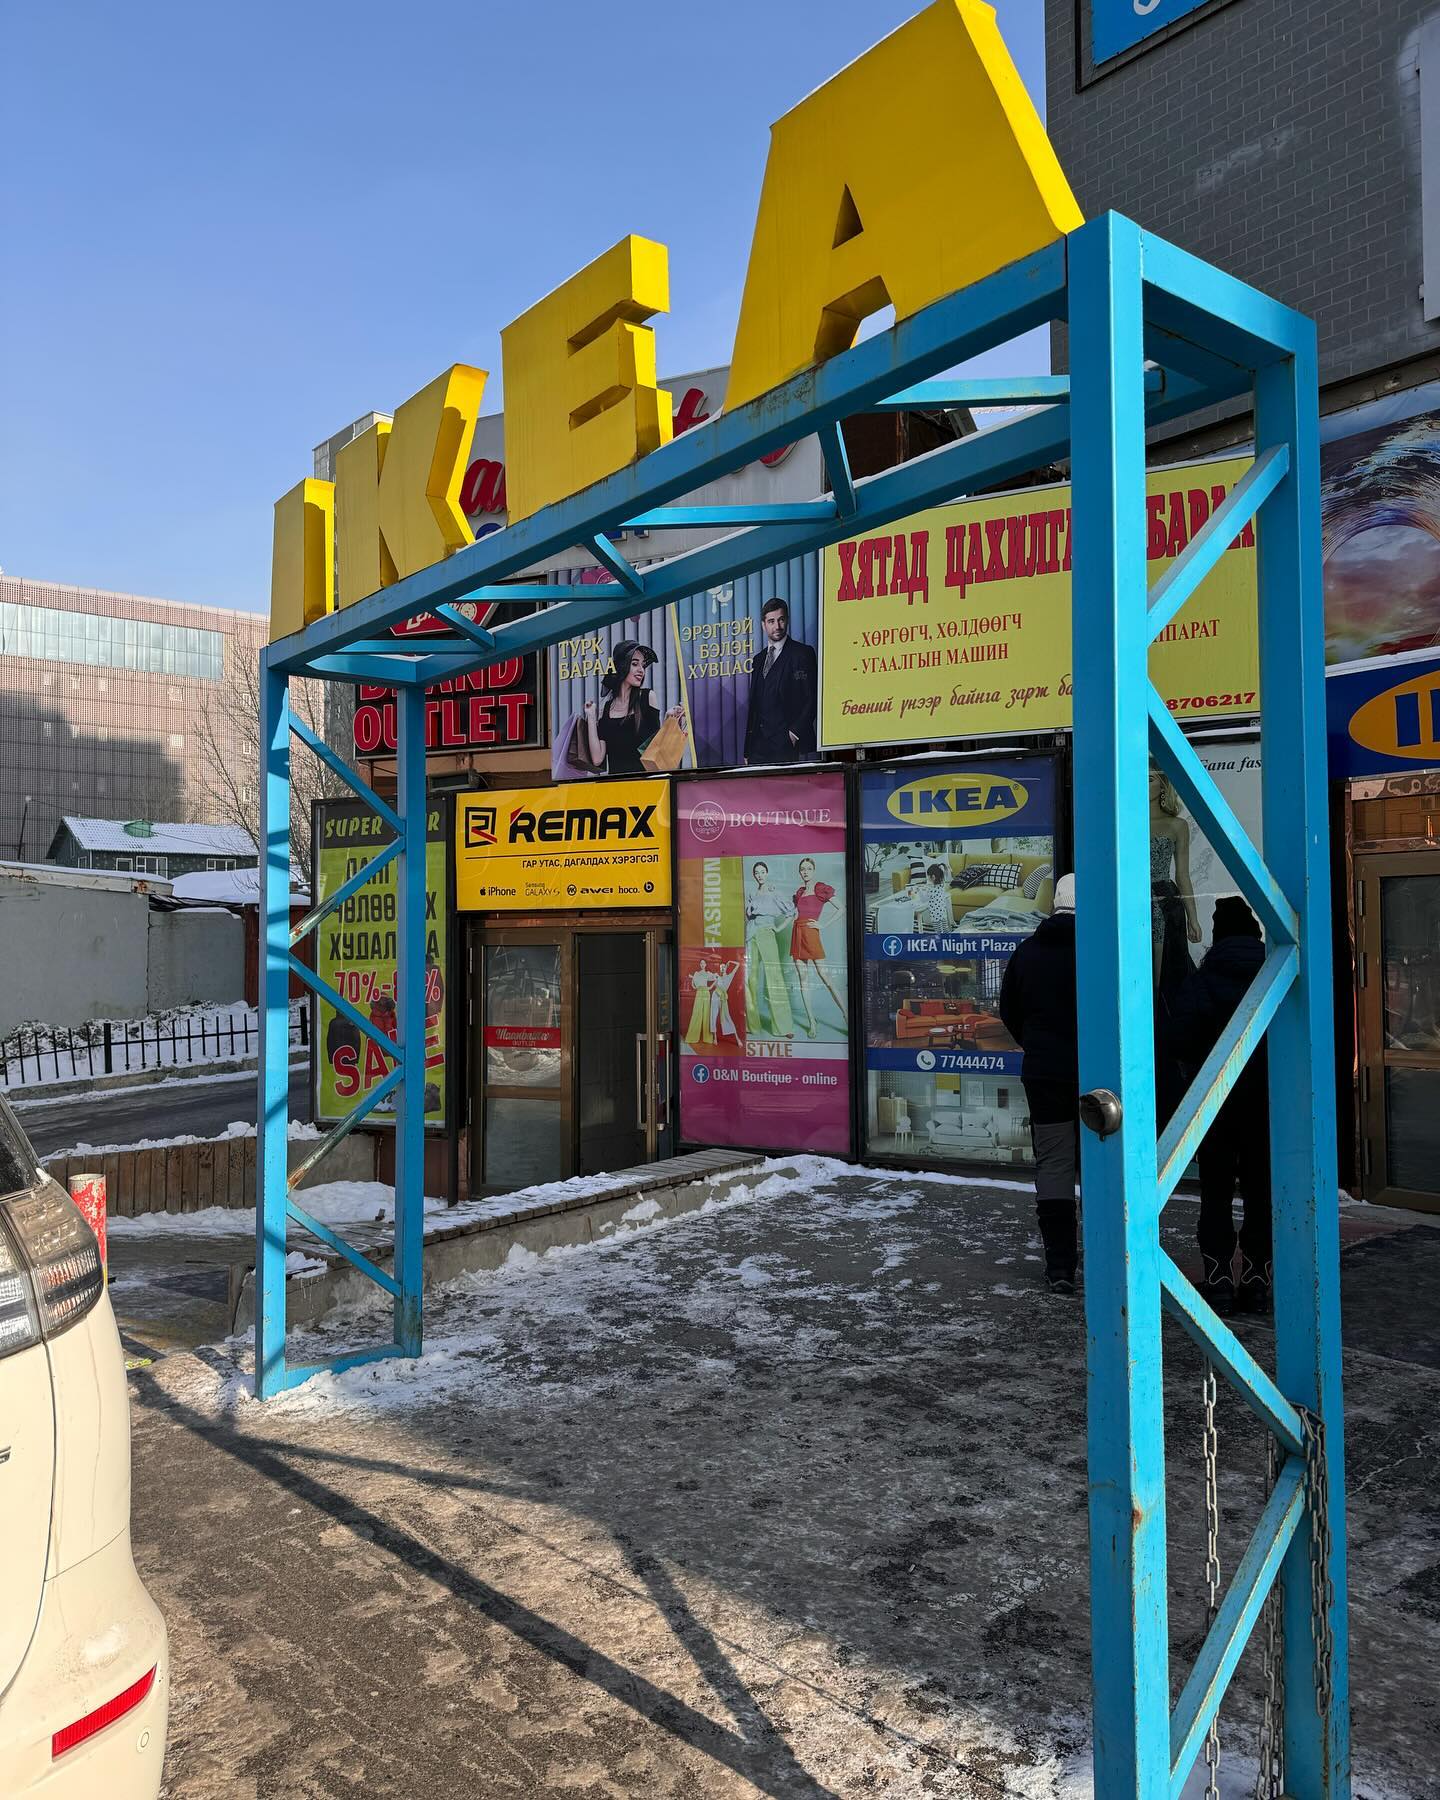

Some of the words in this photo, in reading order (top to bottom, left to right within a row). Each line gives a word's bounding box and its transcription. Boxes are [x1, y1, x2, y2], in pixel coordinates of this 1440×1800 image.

[270, 0, 1084, 643] IKEA
[837, 530, 929, 605] ХЯТАД
[945, 508, 1073, 599] ЦАХИЛГА
[681, 617, 754, 642] ЭРЭГТЭЙ
[861, 624, 933, 648] ХӨРГӨГЧ,
[936, 612, 1023, 640] ХӨЛДӨӨГЧ
[558, 637, 605, 660] ТУРК
[700, 639, 754, 660] БЭЛЭН
[861, 649, 942, 675] УГААЛГЫН
[946, 643, 1009, 666] МАШИН
[559, 657, 618, 681] БАРАА
[688, 658, 755, 681] ХУВЦАС
[899, 785, 1019, 815] IKEA
[325, 816, 383, 838] SUPER
[509, 804, 657, 844] REMAX
[730, 808, 832, 828] BOUTIQUE
[522, 860, 538, 869] ГАР
[539, 859, 563, 869] УТАС,
[564, 856, 610, 867] ДАГАЛДАХ
[612, 854, 659, 865] ХЭРЭГСЭЛ
[488, 886, 517, 896] iPhone
[704, 858, 722, 948] FASHION
[329, 930, 440, 961] ХУДАЛА
[907, 939, 938, 952] IKEA
[942, 938, 977, 956] Night
[981, 939, 1017, 952] Plaza
[746, 1042, 793, 1058] STYLE
[940, 1055, 1005, 1070] 77444474
[713, 1068, 739, 1082] O&N
[742, 1070, 792, 1086] Boutique
[802, 1072, 838, 1086] online
